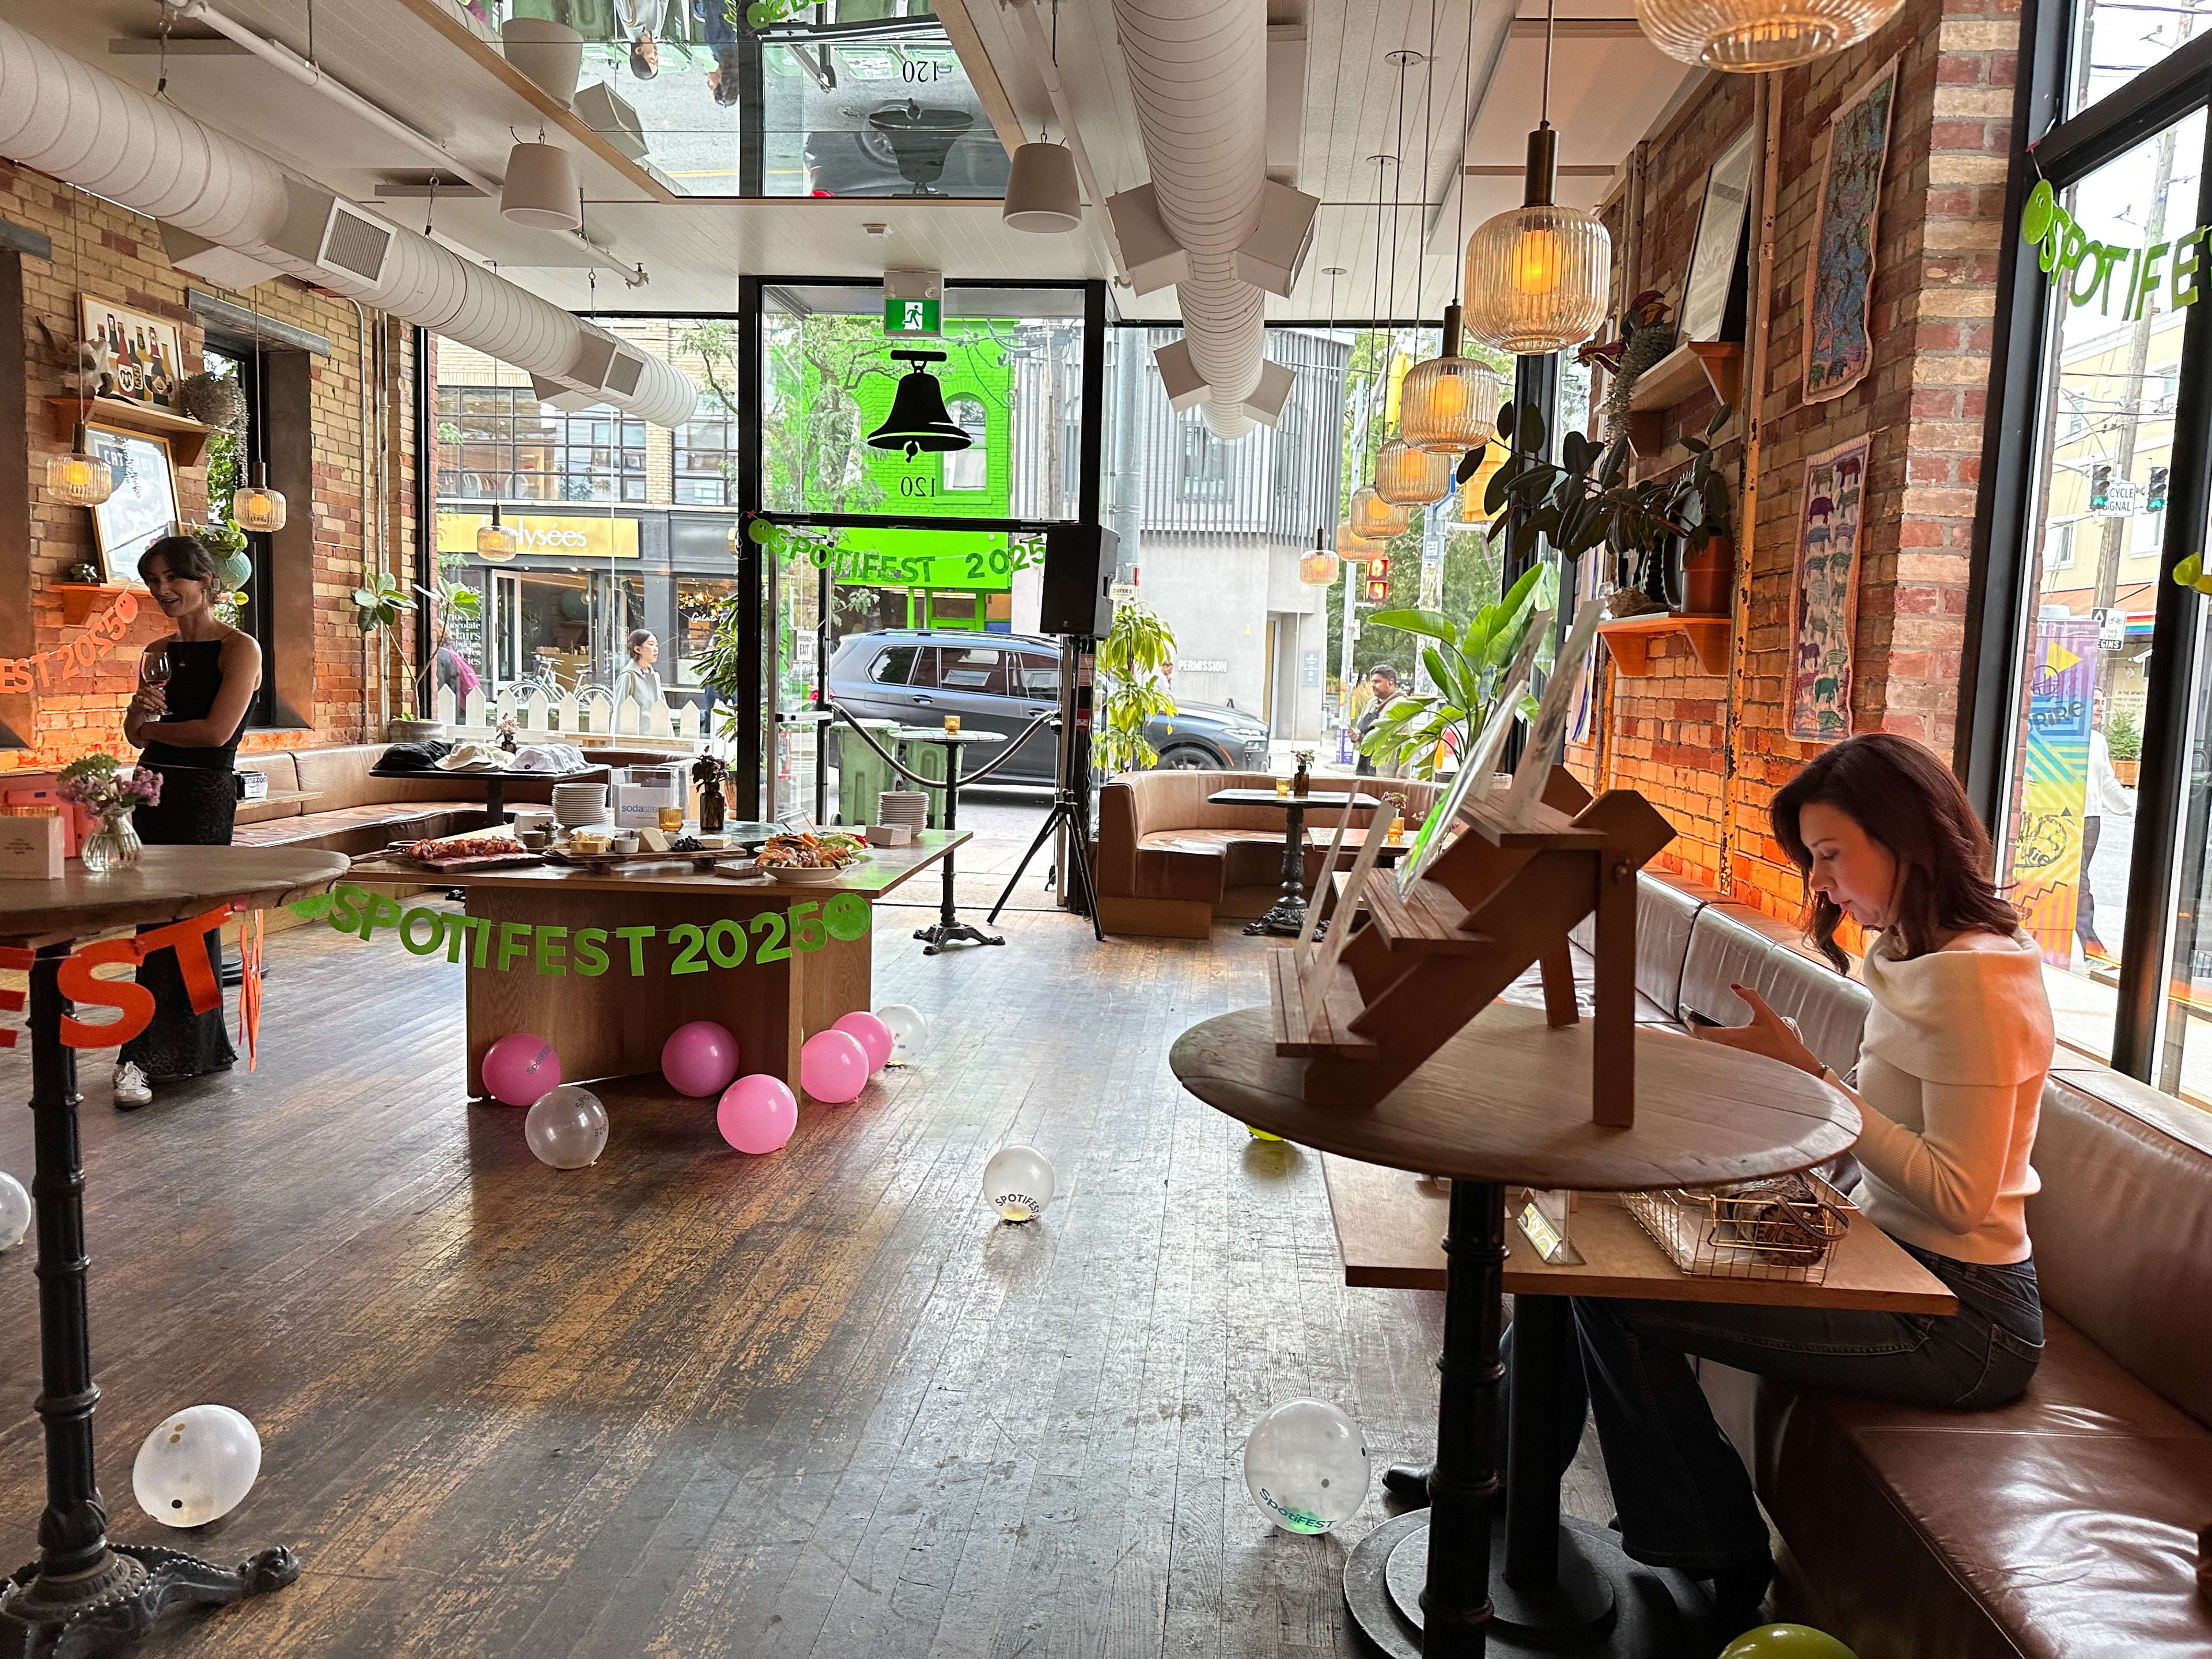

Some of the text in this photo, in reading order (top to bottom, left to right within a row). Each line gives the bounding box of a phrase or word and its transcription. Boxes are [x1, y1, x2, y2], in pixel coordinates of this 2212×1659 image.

[902, 60, 938, 82] 120
[2039, 206, 2212, 321] SPOTIFE
[768, 528, 1047, 583] SPOTIFEST 2025
[447, 619, 481, 630] hocolate
[57, 606, 126, 681] 2025
[800, 644, 809, 656] EXIT
[2097, 640, 2119, 649] EGINS
[1178, 659, 1228, 673] PERMISSION
[622, 804, 658, 813] sodastre
[328, 884, 827, 977] SPOTIFEST 2025
[995, 1194, 1039, 1215] SPOTIFEST
[1260, 1488, 1337, 1528] SpotiFEST
